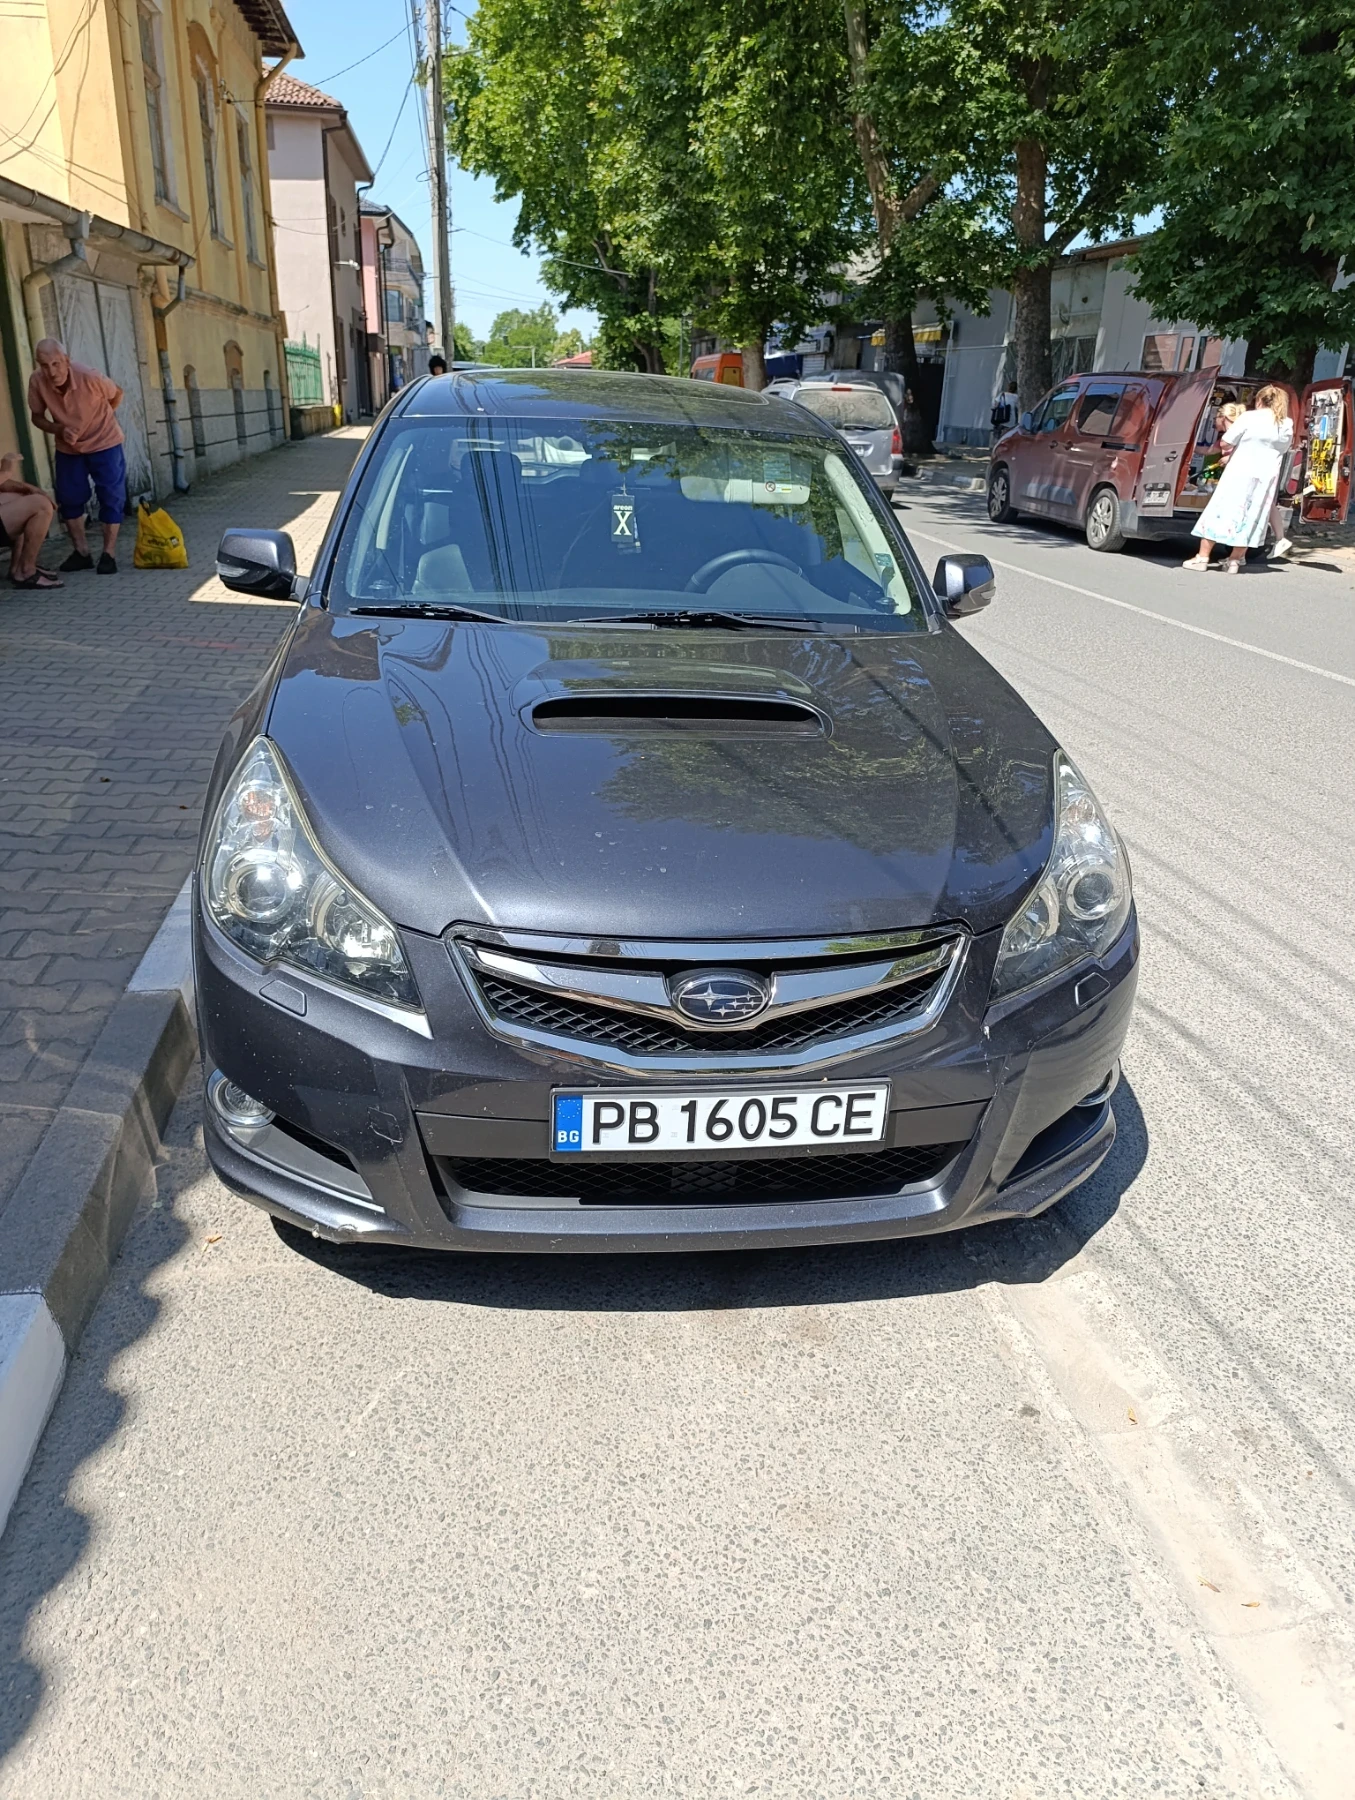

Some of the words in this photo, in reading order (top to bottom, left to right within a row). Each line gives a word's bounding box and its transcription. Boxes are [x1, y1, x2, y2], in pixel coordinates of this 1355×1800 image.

[613, 510, 633, 536] X
[592, 1100, 661, 1144] PB
[680, 1096, 798, 1143] 1605
[810, 1092, 877, 1137] CE
[557, 1130, 580, 1143] BG
